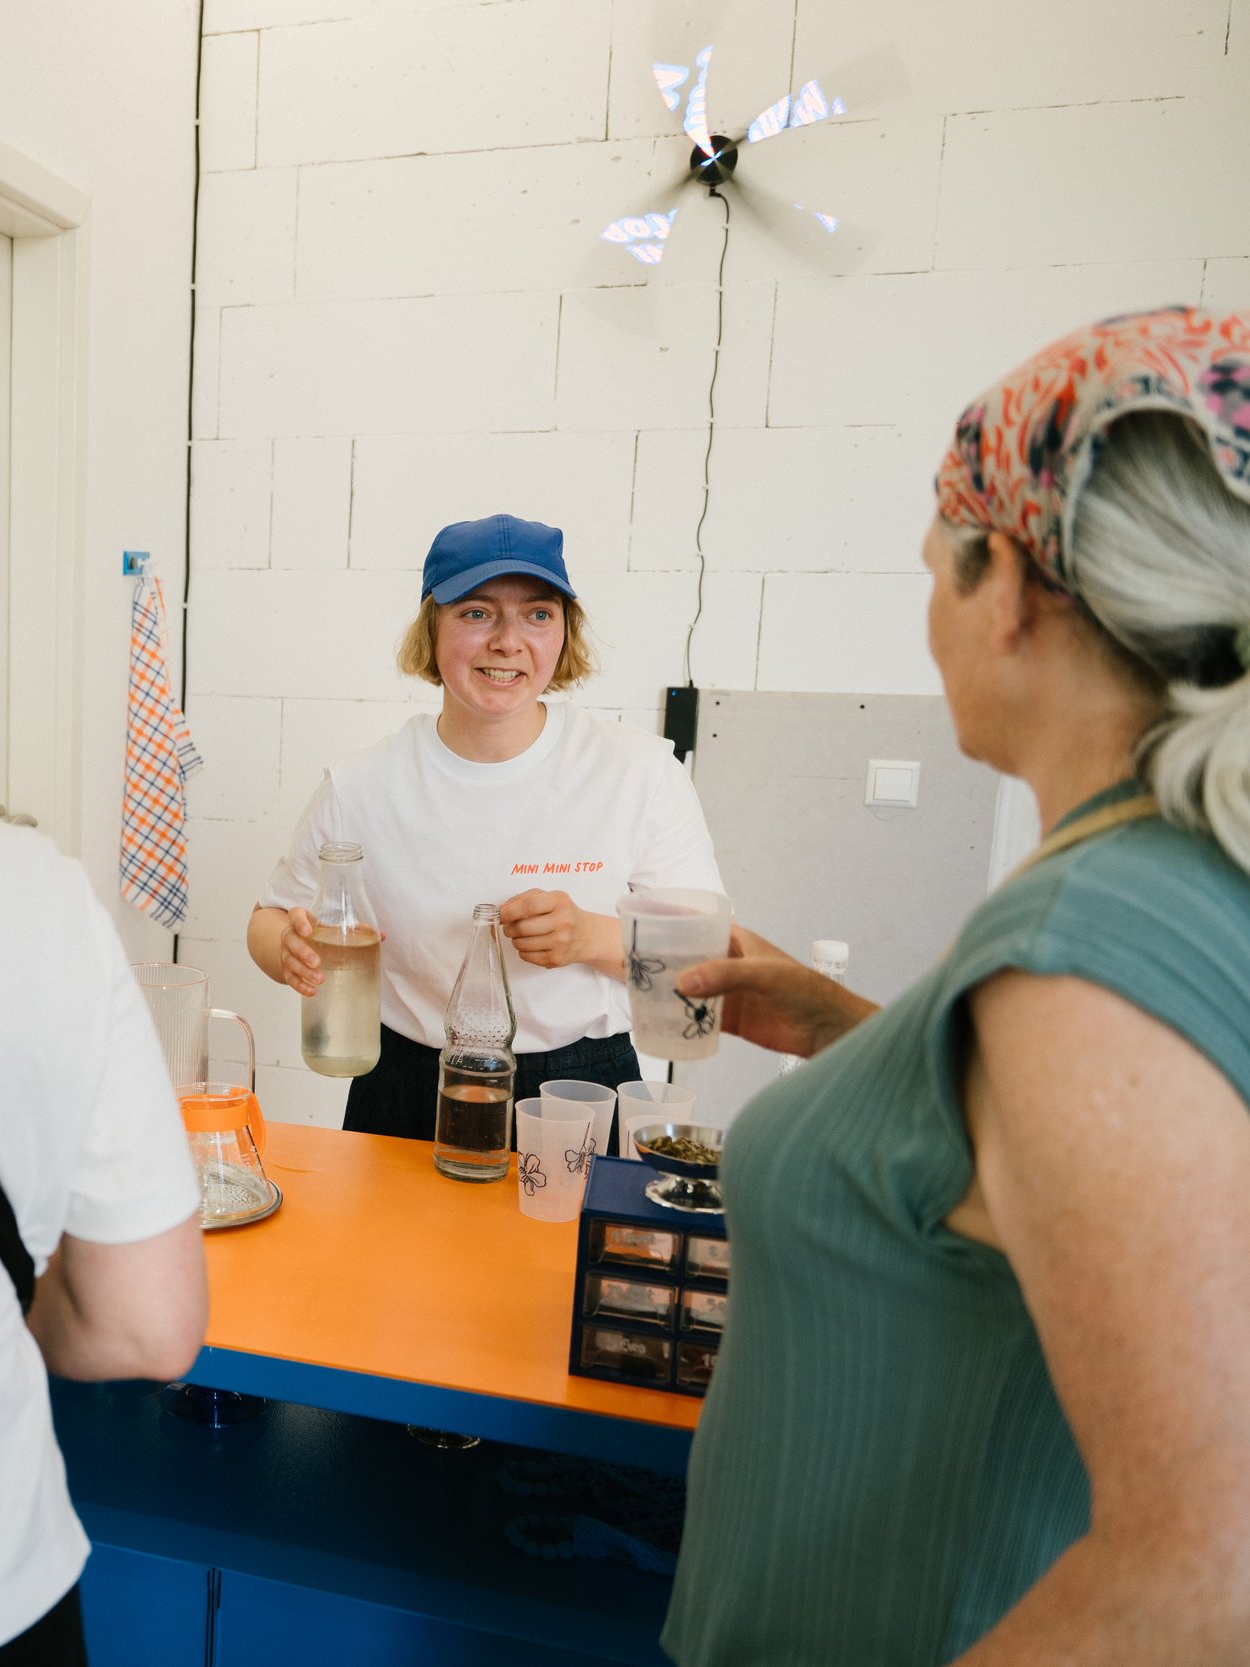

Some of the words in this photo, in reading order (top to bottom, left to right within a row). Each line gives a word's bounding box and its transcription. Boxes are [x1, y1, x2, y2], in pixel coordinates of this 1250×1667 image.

[511, 863, 539, 875] MINI
[543, 862, 571, 874] MINI
[574, 861, 603, 873] STOP
